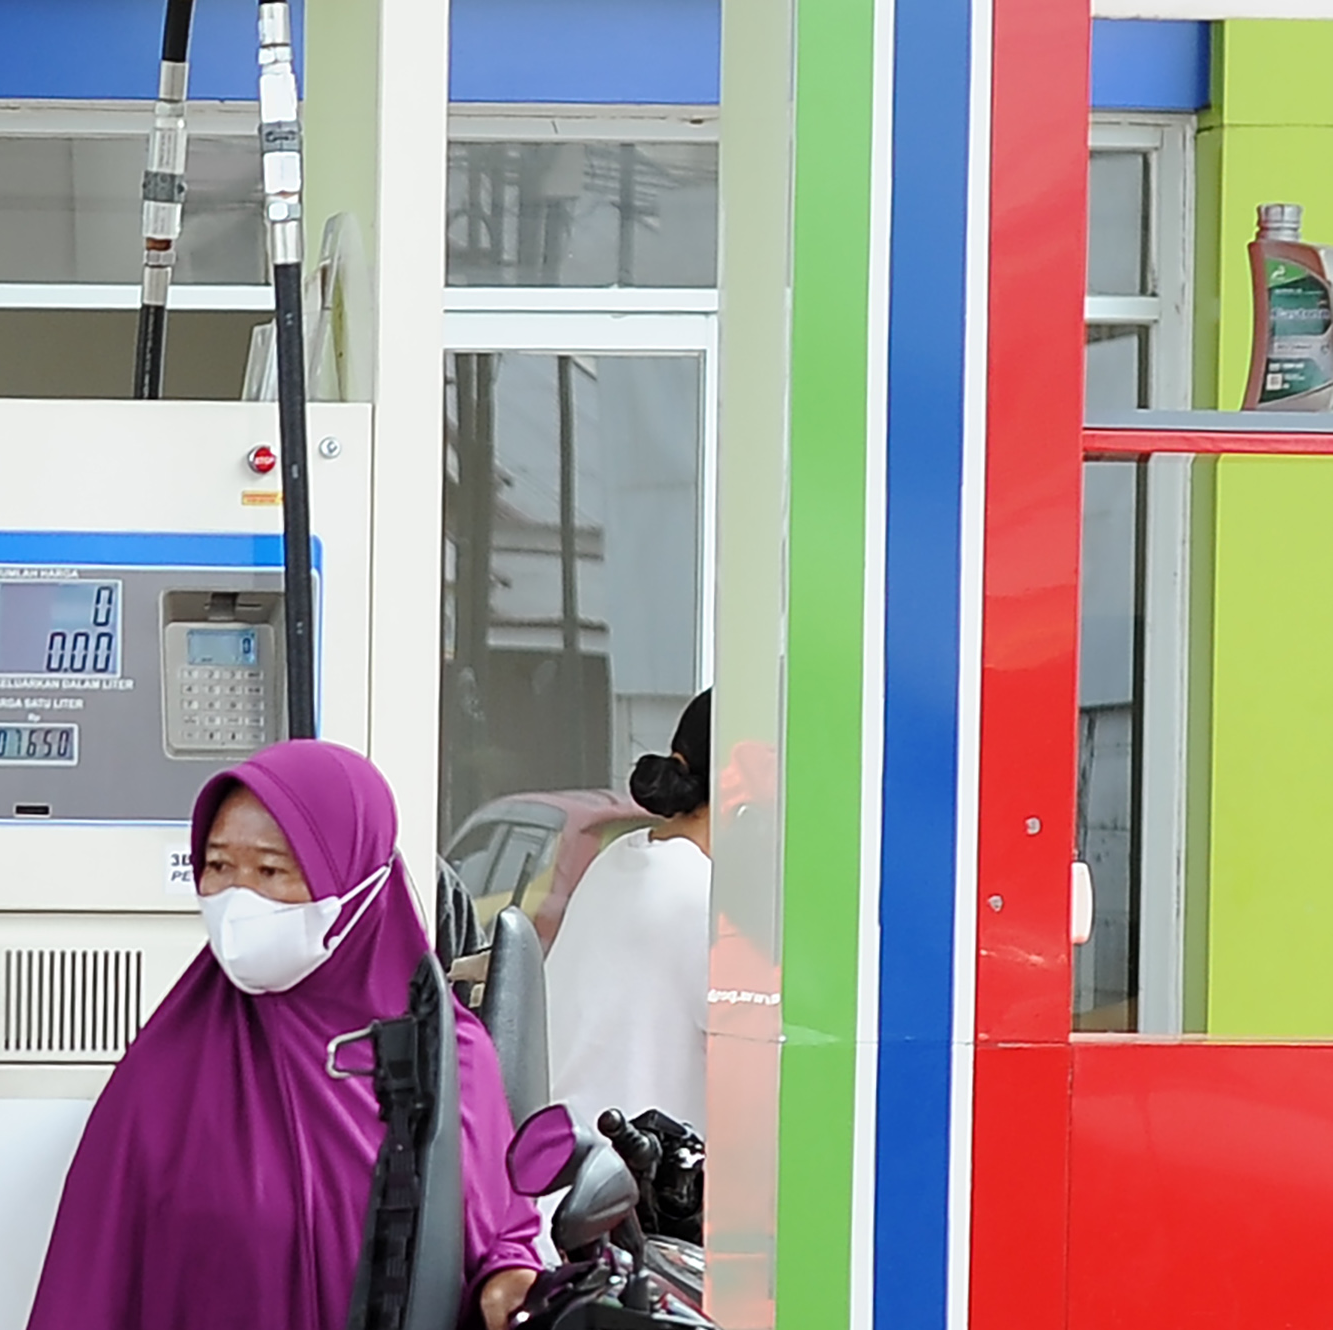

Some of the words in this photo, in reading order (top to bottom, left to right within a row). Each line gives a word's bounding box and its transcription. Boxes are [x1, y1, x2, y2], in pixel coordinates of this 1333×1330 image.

[39, 569, 79, 579] HARGA
[93, 586, 114, 627] 0
[46, 631, 114, 673] 0.00
[61, 679, 101, 690] DALAM
[102, 680, 135, 690] LITER
[24, 698, 51, 709] SATU
[52, 699, 84, 709] LITER
